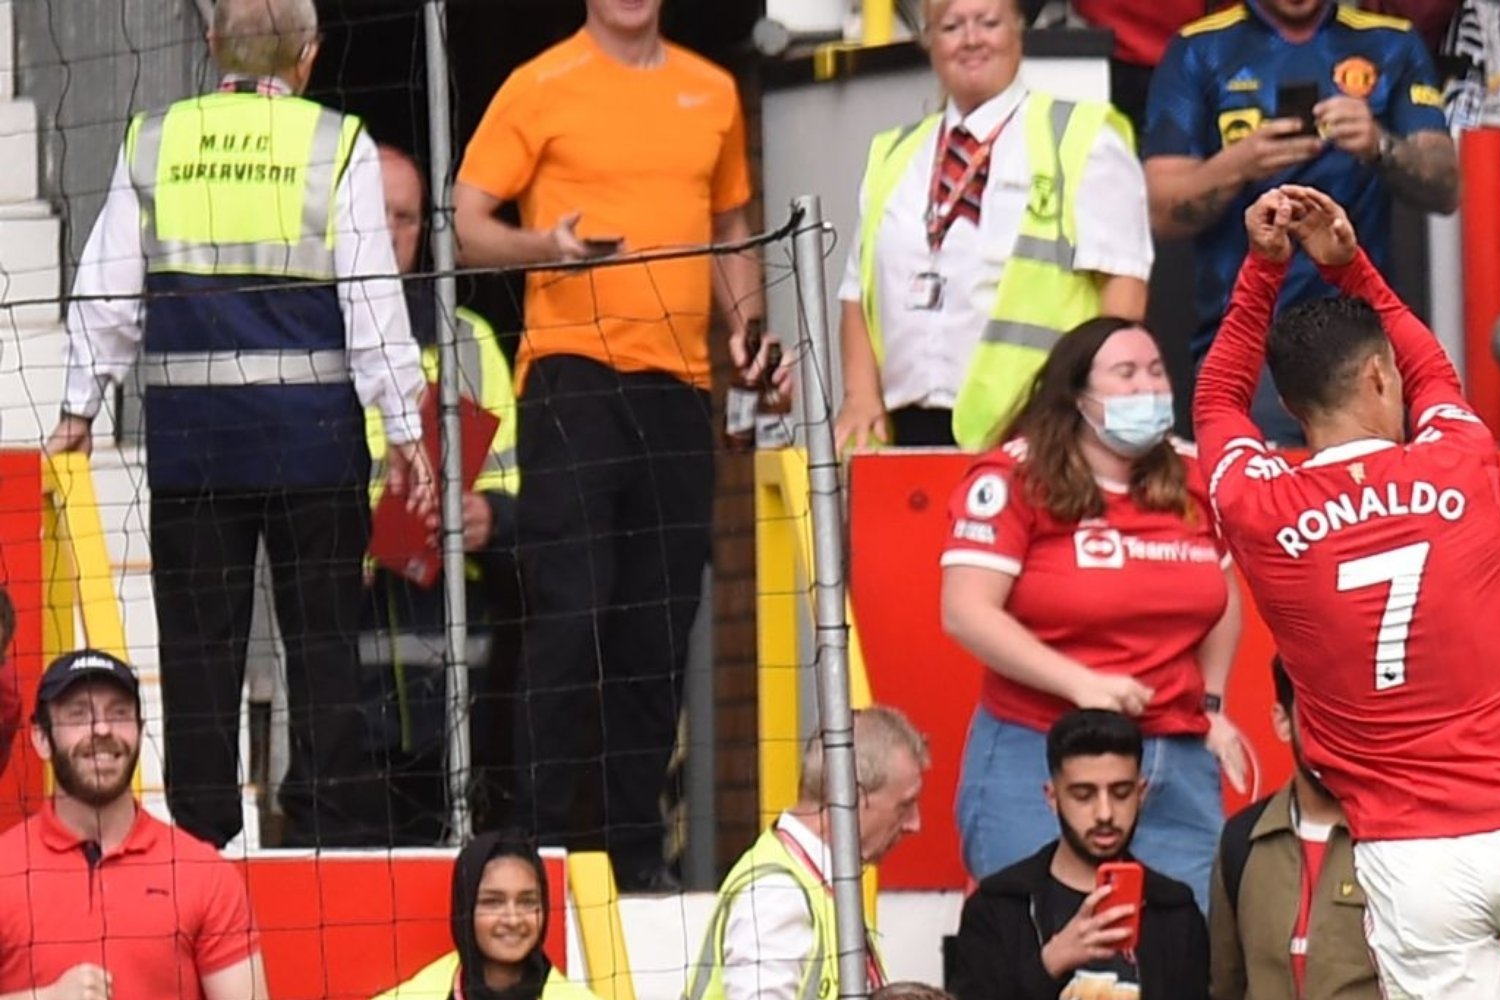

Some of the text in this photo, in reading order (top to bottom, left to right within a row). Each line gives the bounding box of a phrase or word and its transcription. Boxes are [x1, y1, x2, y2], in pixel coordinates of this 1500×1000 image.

[169, 162, 297, 184] SUPERVISOR
[1276, 480, 1467, 559] RONALDO
[1337, 541, 1431, 692] 7
